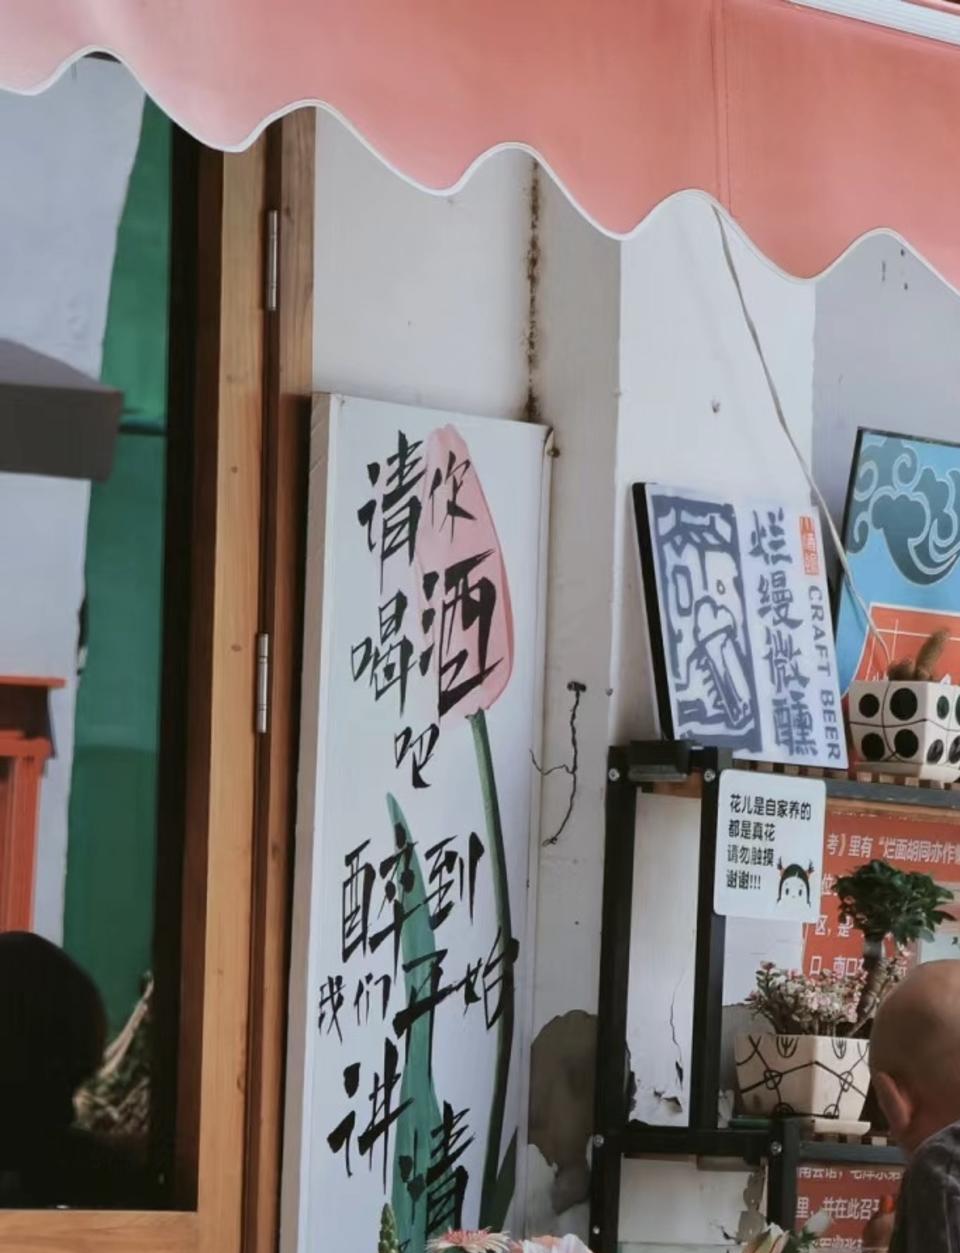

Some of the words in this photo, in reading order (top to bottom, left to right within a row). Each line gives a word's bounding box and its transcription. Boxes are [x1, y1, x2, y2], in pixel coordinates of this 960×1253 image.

[808, 585, 832, 678] CRAFT
[821, 689, 842, 760] BEER
[730, 793, 812, 821] 花儿是自家养的
[728, 818, 776, 842] 都是真花
[726, 844, 775, 867] 请勿触摸
